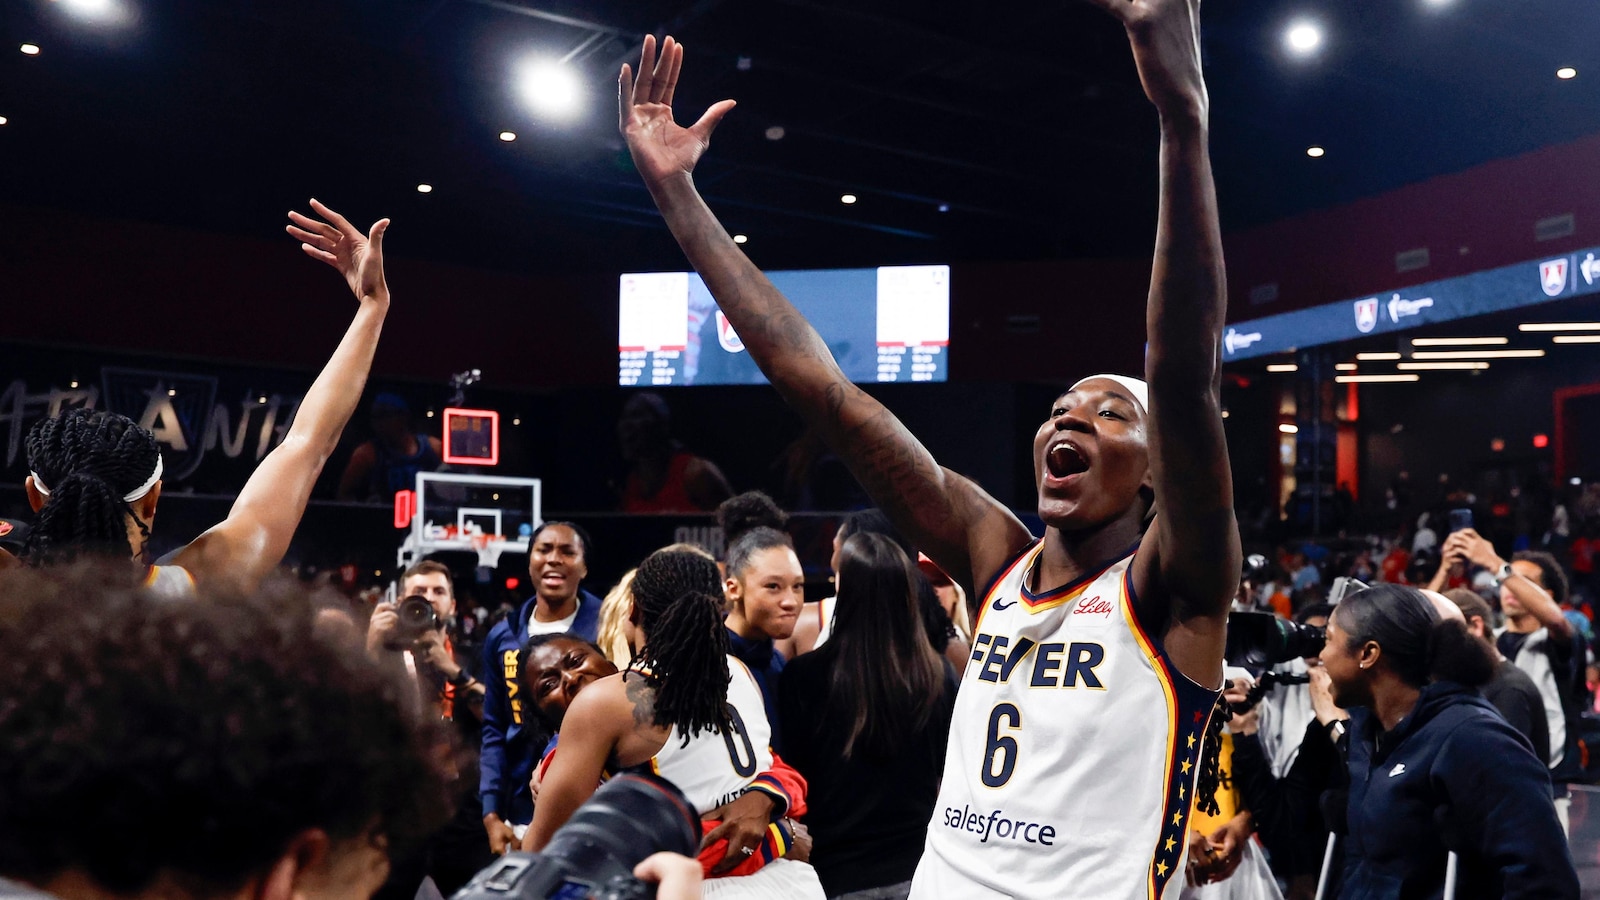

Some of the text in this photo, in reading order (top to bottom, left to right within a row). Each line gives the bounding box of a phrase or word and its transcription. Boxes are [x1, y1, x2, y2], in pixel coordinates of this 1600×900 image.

[1073, 595, 1114, 619] Lilly
[970, 632, 1107, 691] FEVER
[981, 701, 1022, 790] 6
[943, 804, 1056, 846] salesforce
